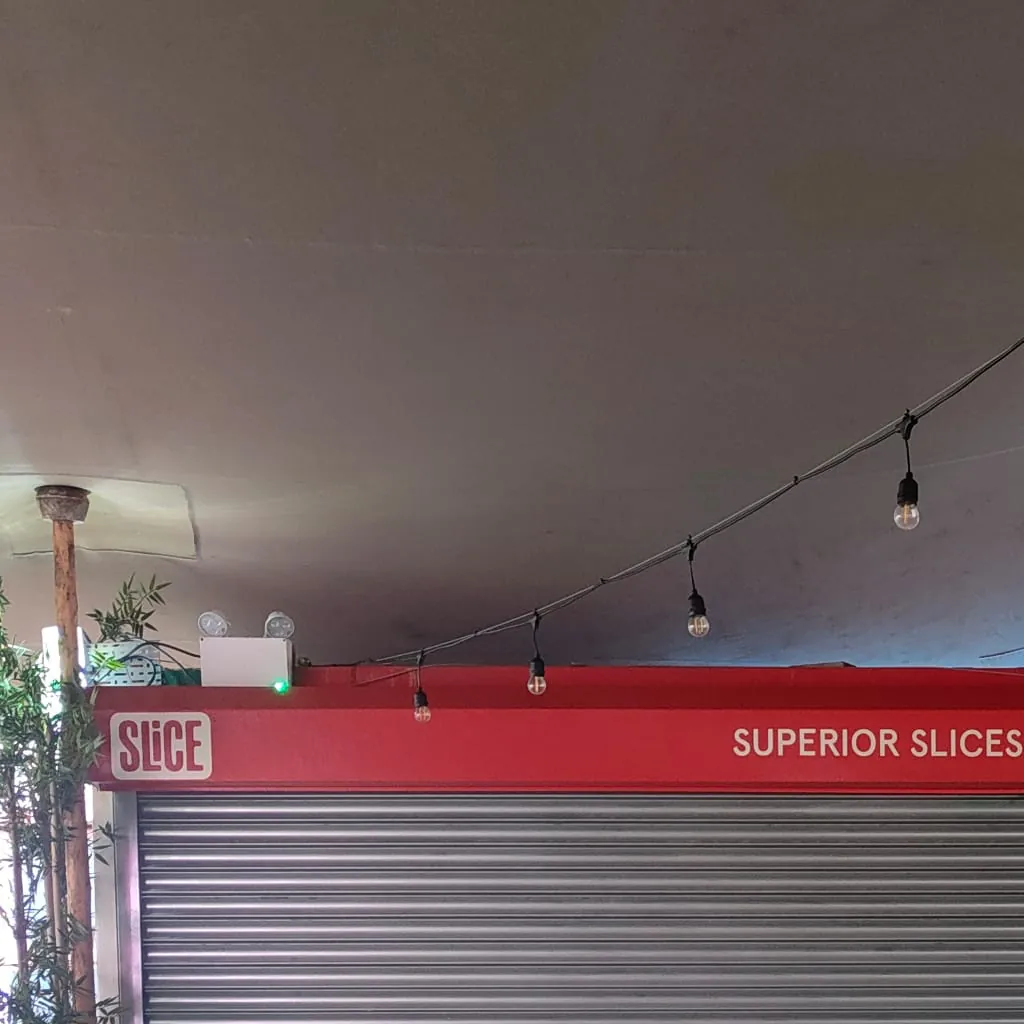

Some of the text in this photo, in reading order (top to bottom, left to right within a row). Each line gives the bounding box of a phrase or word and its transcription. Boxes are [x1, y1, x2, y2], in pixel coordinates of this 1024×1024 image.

[119, 719, 204, 772] SLiCE
[732, 728, 900, 758] SUPERIOR
[910, 728, 1024, 758] SLICES
